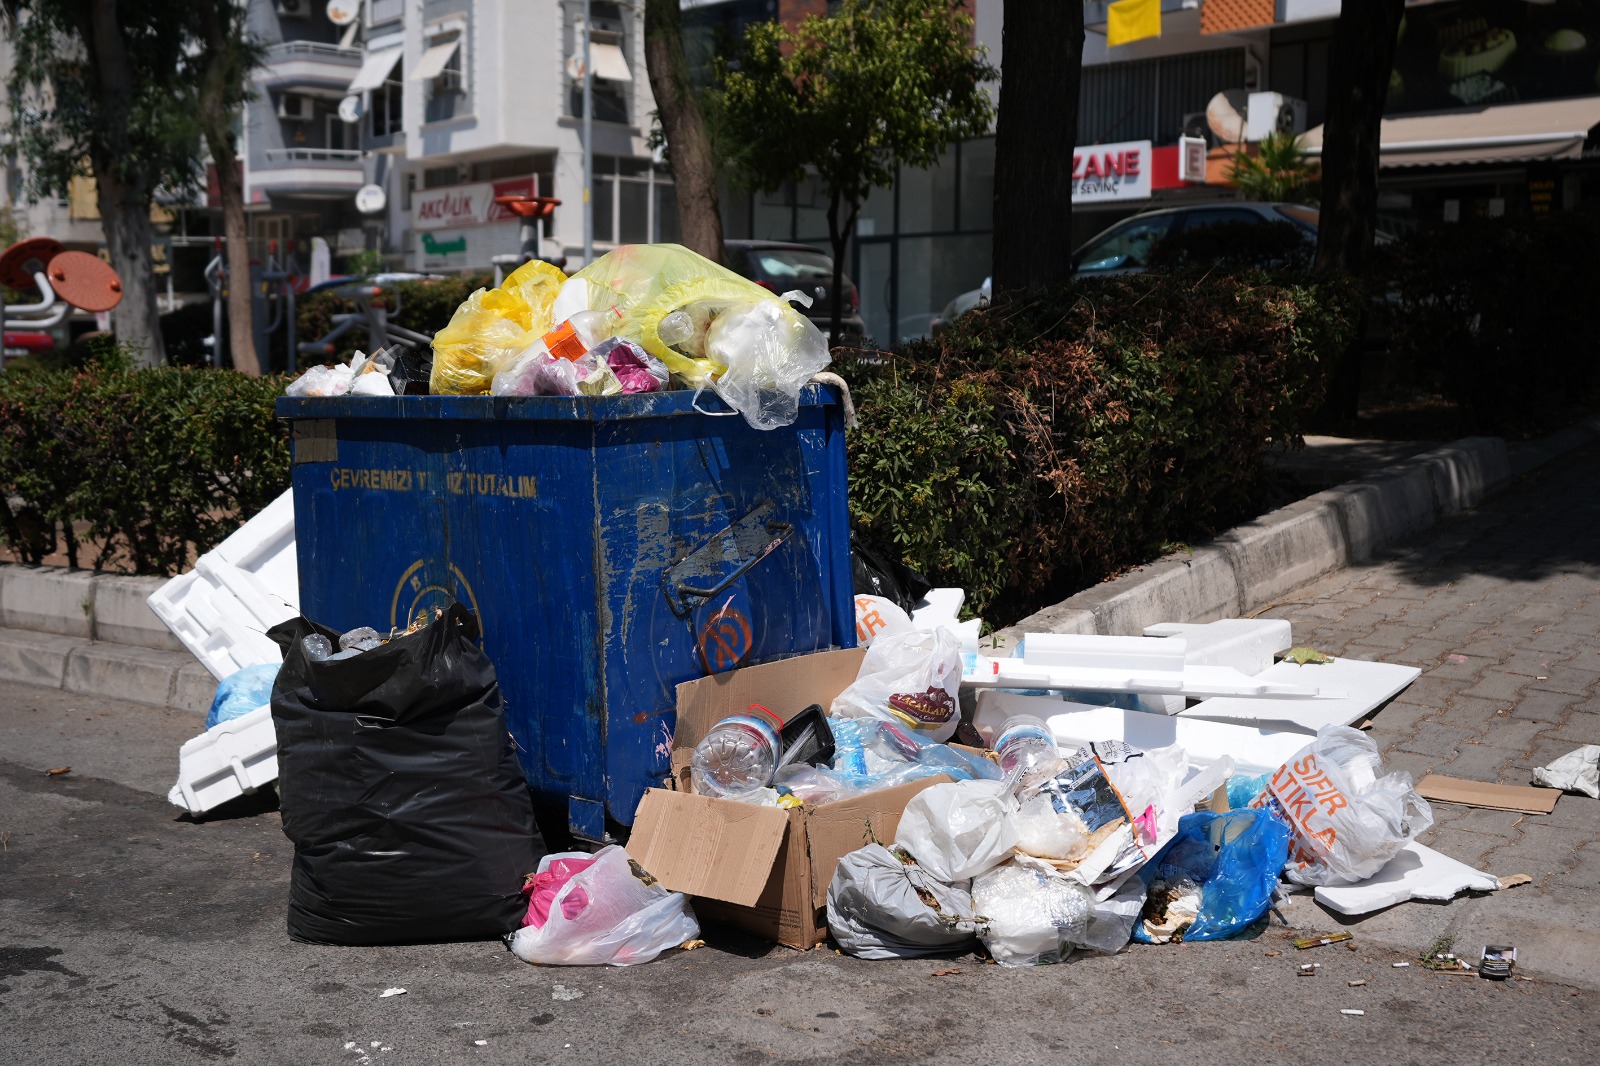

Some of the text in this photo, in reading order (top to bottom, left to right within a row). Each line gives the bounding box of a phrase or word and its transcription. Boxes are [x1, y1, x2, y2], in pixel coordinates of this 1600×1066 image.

[1189, 148, 1200, 172] E
[330, 466, 413, 492] ÇEVREMİZİ
[466, 472, 537, 499] TUTALIM
[1294, 754, 1347, 816] SIFIR
